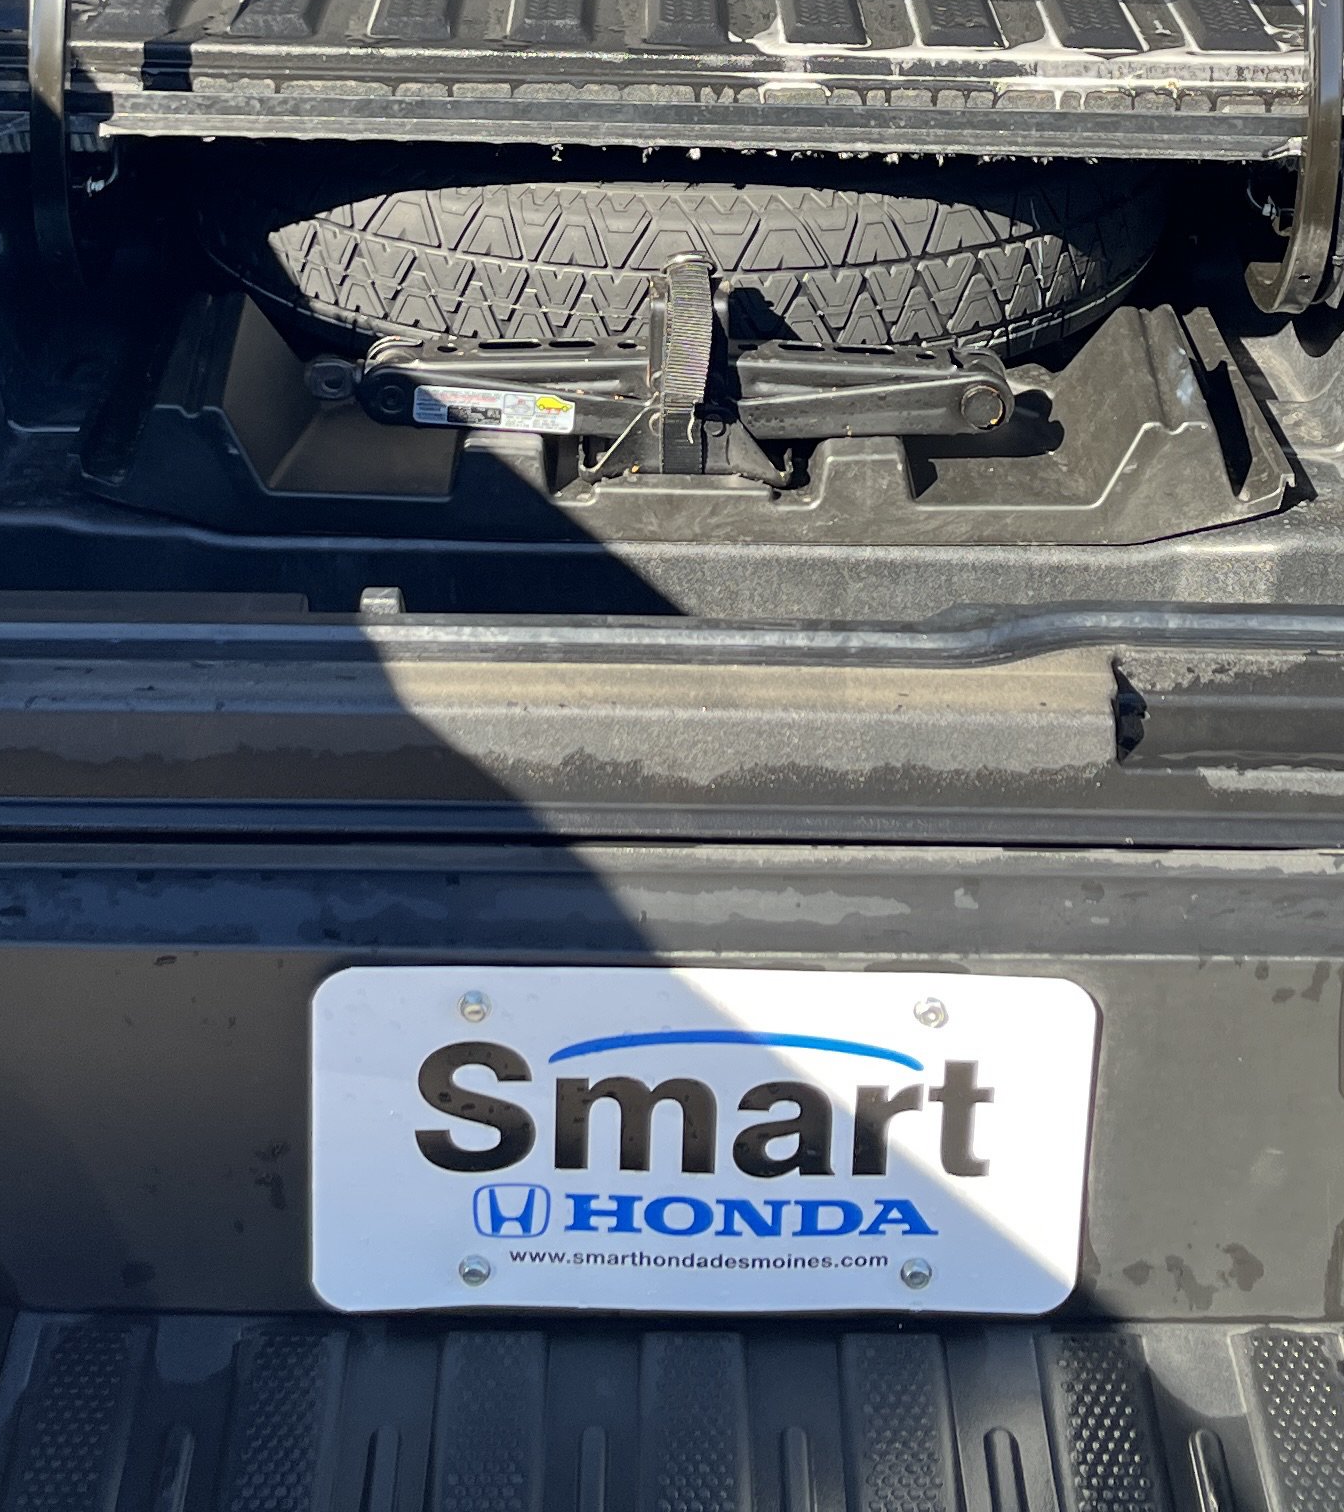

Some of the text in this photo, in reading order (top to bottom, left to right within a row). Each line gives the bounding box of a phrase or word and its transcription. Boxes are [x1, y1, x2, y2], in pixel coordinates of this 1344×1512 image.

[415, 1041, 995, 1179] Smart
[565, 1193, 939, 1238] HONDA
[509, 1249, 889, 1270] www.smarthondadesmoines.com
